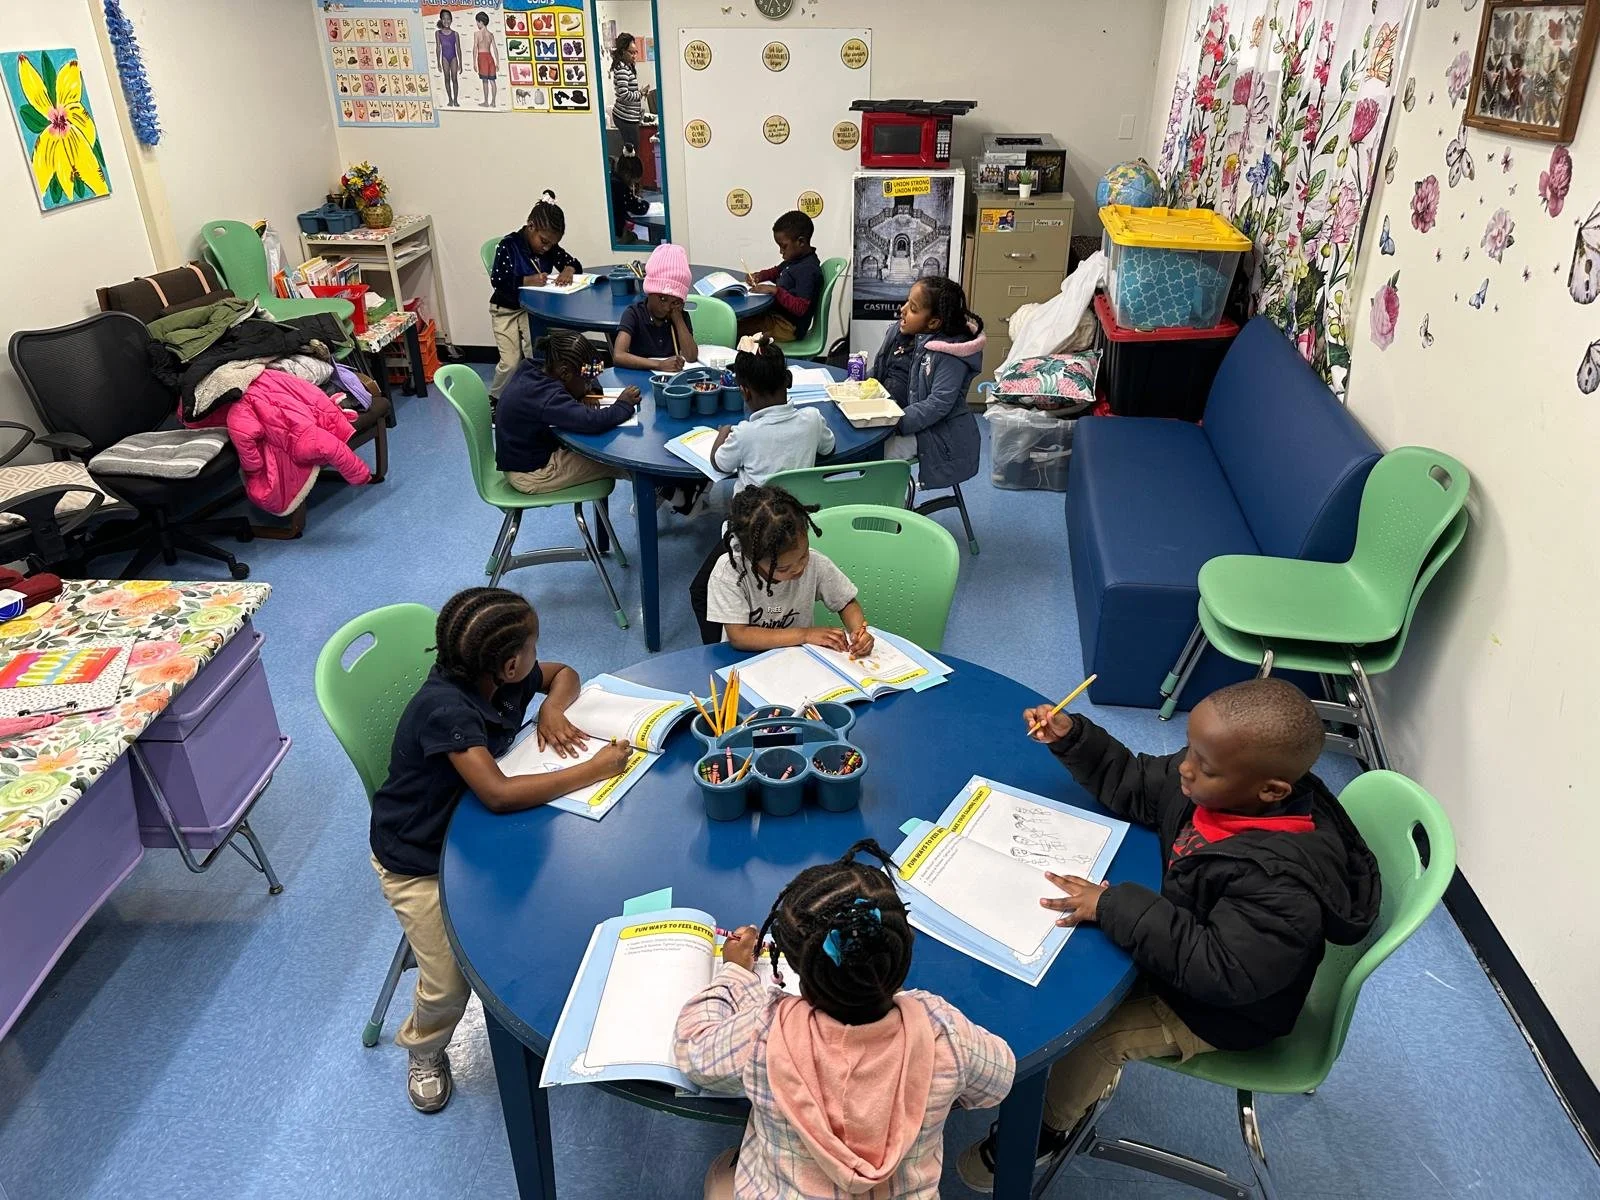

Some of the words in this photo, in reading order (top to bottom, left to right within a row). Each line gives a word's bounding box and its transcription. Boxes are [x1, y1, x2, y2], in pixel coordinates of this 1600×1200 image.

[863, 303, 902, 311] CASTILLA
[767, 606, 782, 614] FREE
[640, 724, 651, 741] BETTER
[907, 856, 918, 868] FUN
[915, 845, 928, 859] WAYS
[930, 831, 940, 841] FEEL
